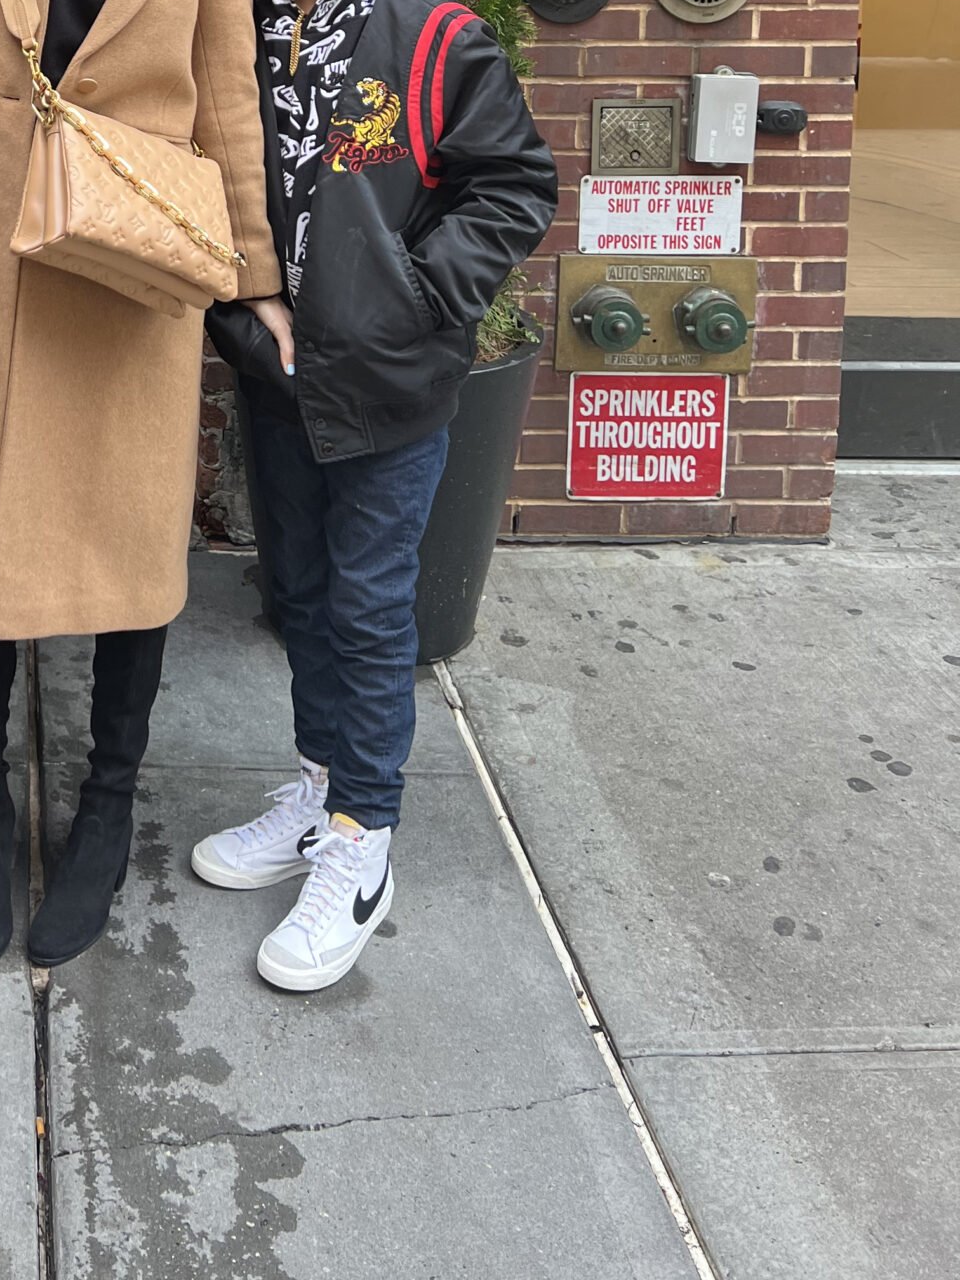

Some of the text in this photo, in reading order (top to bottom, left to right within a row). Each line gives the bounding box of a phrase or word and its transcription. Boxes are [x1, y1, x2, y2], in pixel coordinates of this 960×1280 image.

[322, 131, 410, 174] Tigers
[592, 180, 732, 196] AUTOMATIC SPRINKLER
[608, 198, 714, 213] SHUT OFF VALVE
[676, 217, 706, 231] FEET
[598, 234, 721, 250] OPPOSITE THIS SIGN
[608, 266, 707, 281] AUTO SPRINKLER
[611, 354, 633, 365] FIRE
[579, 389, 716, 417] SPRINKLERS
[576, 421, 720, 449] THROUGHOUT
[596, 454, 697, 482] BUILDING
